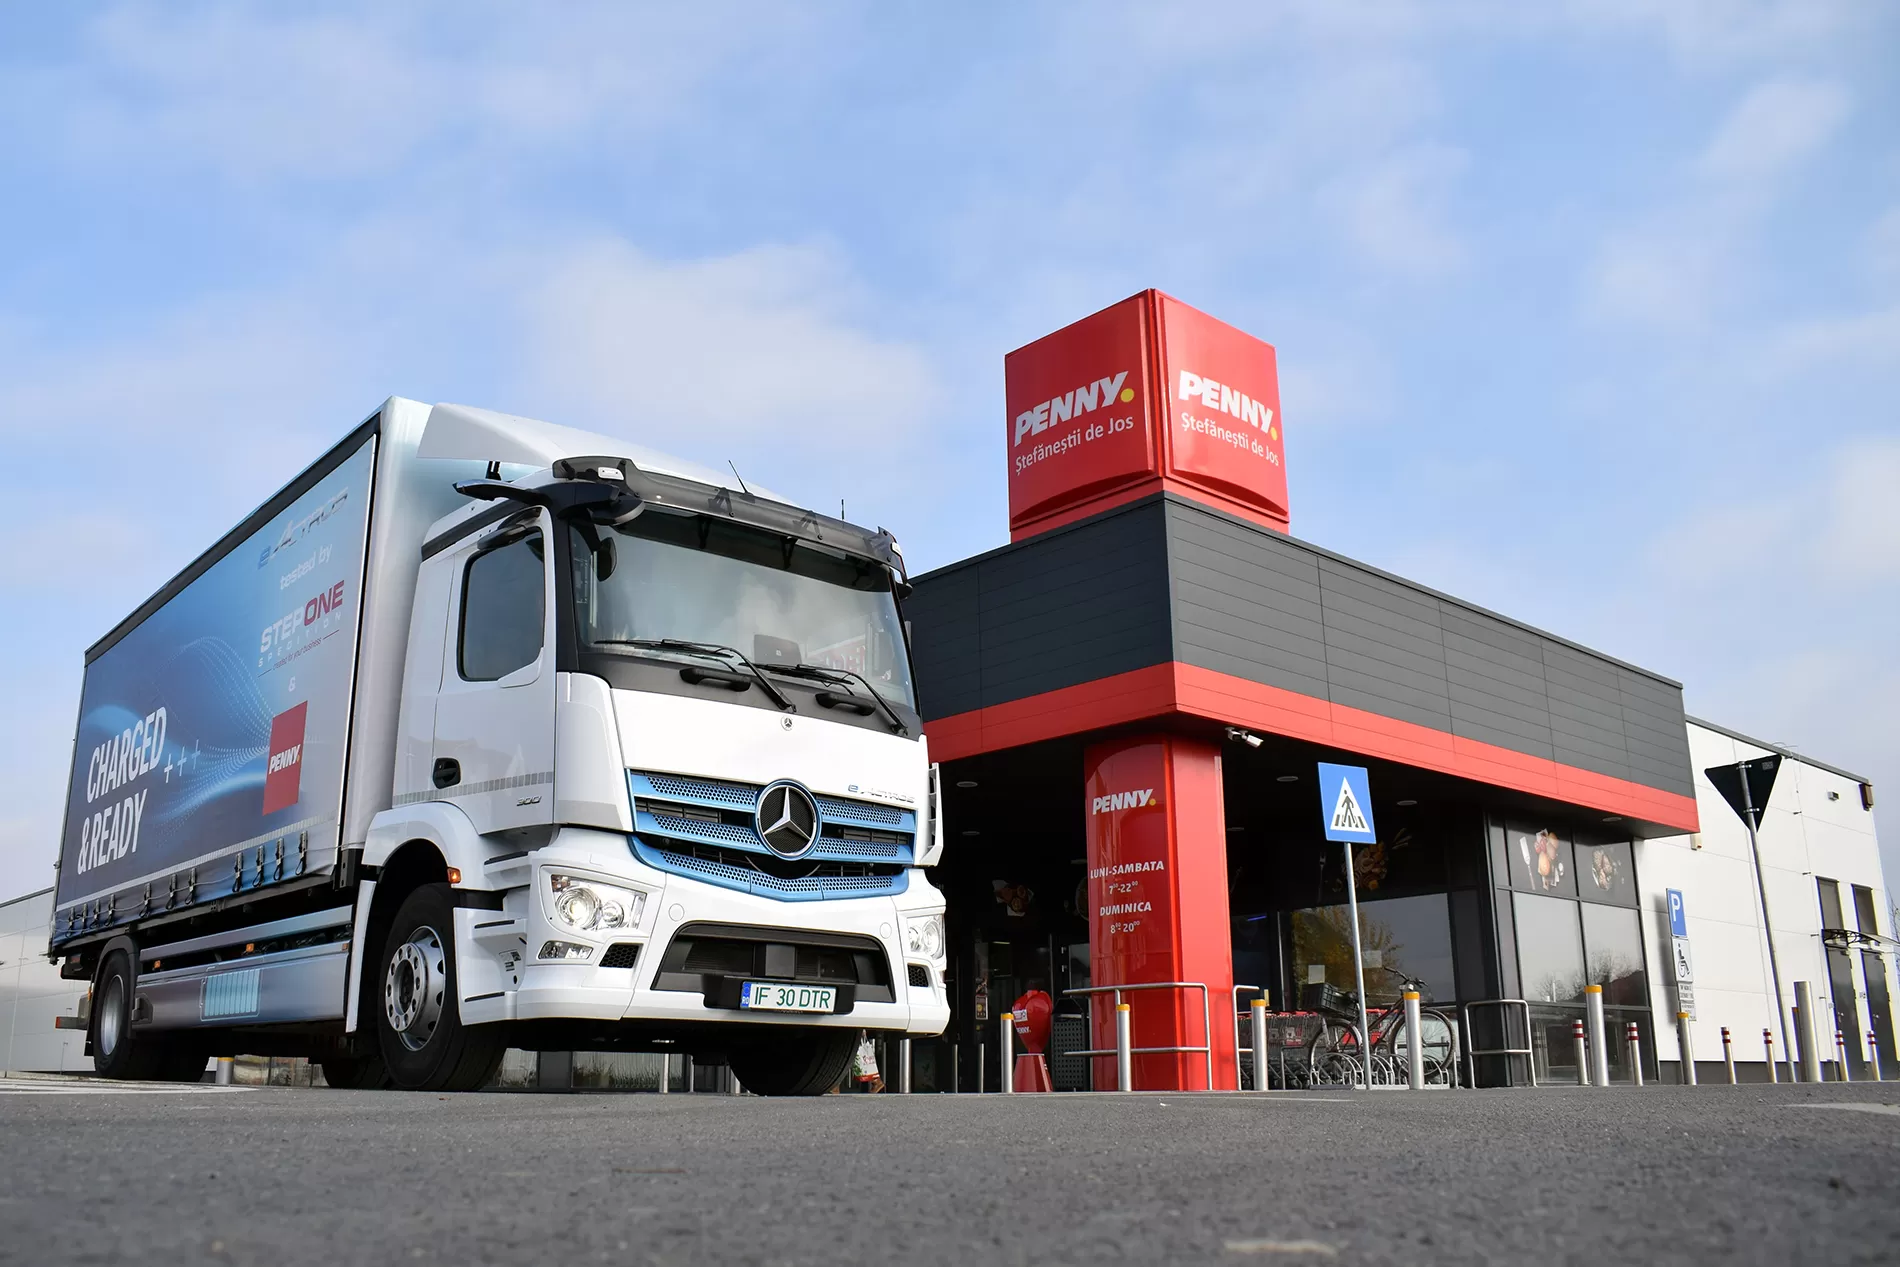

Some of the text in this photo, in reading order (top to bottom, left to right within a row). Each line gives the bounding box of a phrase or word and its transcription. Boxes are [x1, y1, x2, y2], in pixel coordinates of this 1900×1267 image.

[1085, 419, 1104, 442] de
[1107, 416, 1134, 435] Jos
[1251, 438, 1264, 457] de
[1265, 445, 1279, 467] Jos
[280, 543, 333, 590] tested by
[87, 706, 167, 803] CHARGED
[516, 795, 542, 807] 300
[1090, 860, 1164, 879] LUNI-SAMBATA
[1100, 901, 1152, 916] DUMINICA
[1670, 893, 1681, 922] P
[754, 986, 771, 1005] IF
[776, 988, 795, 1006] 30
[799, 989, 831, 1008] DTR
